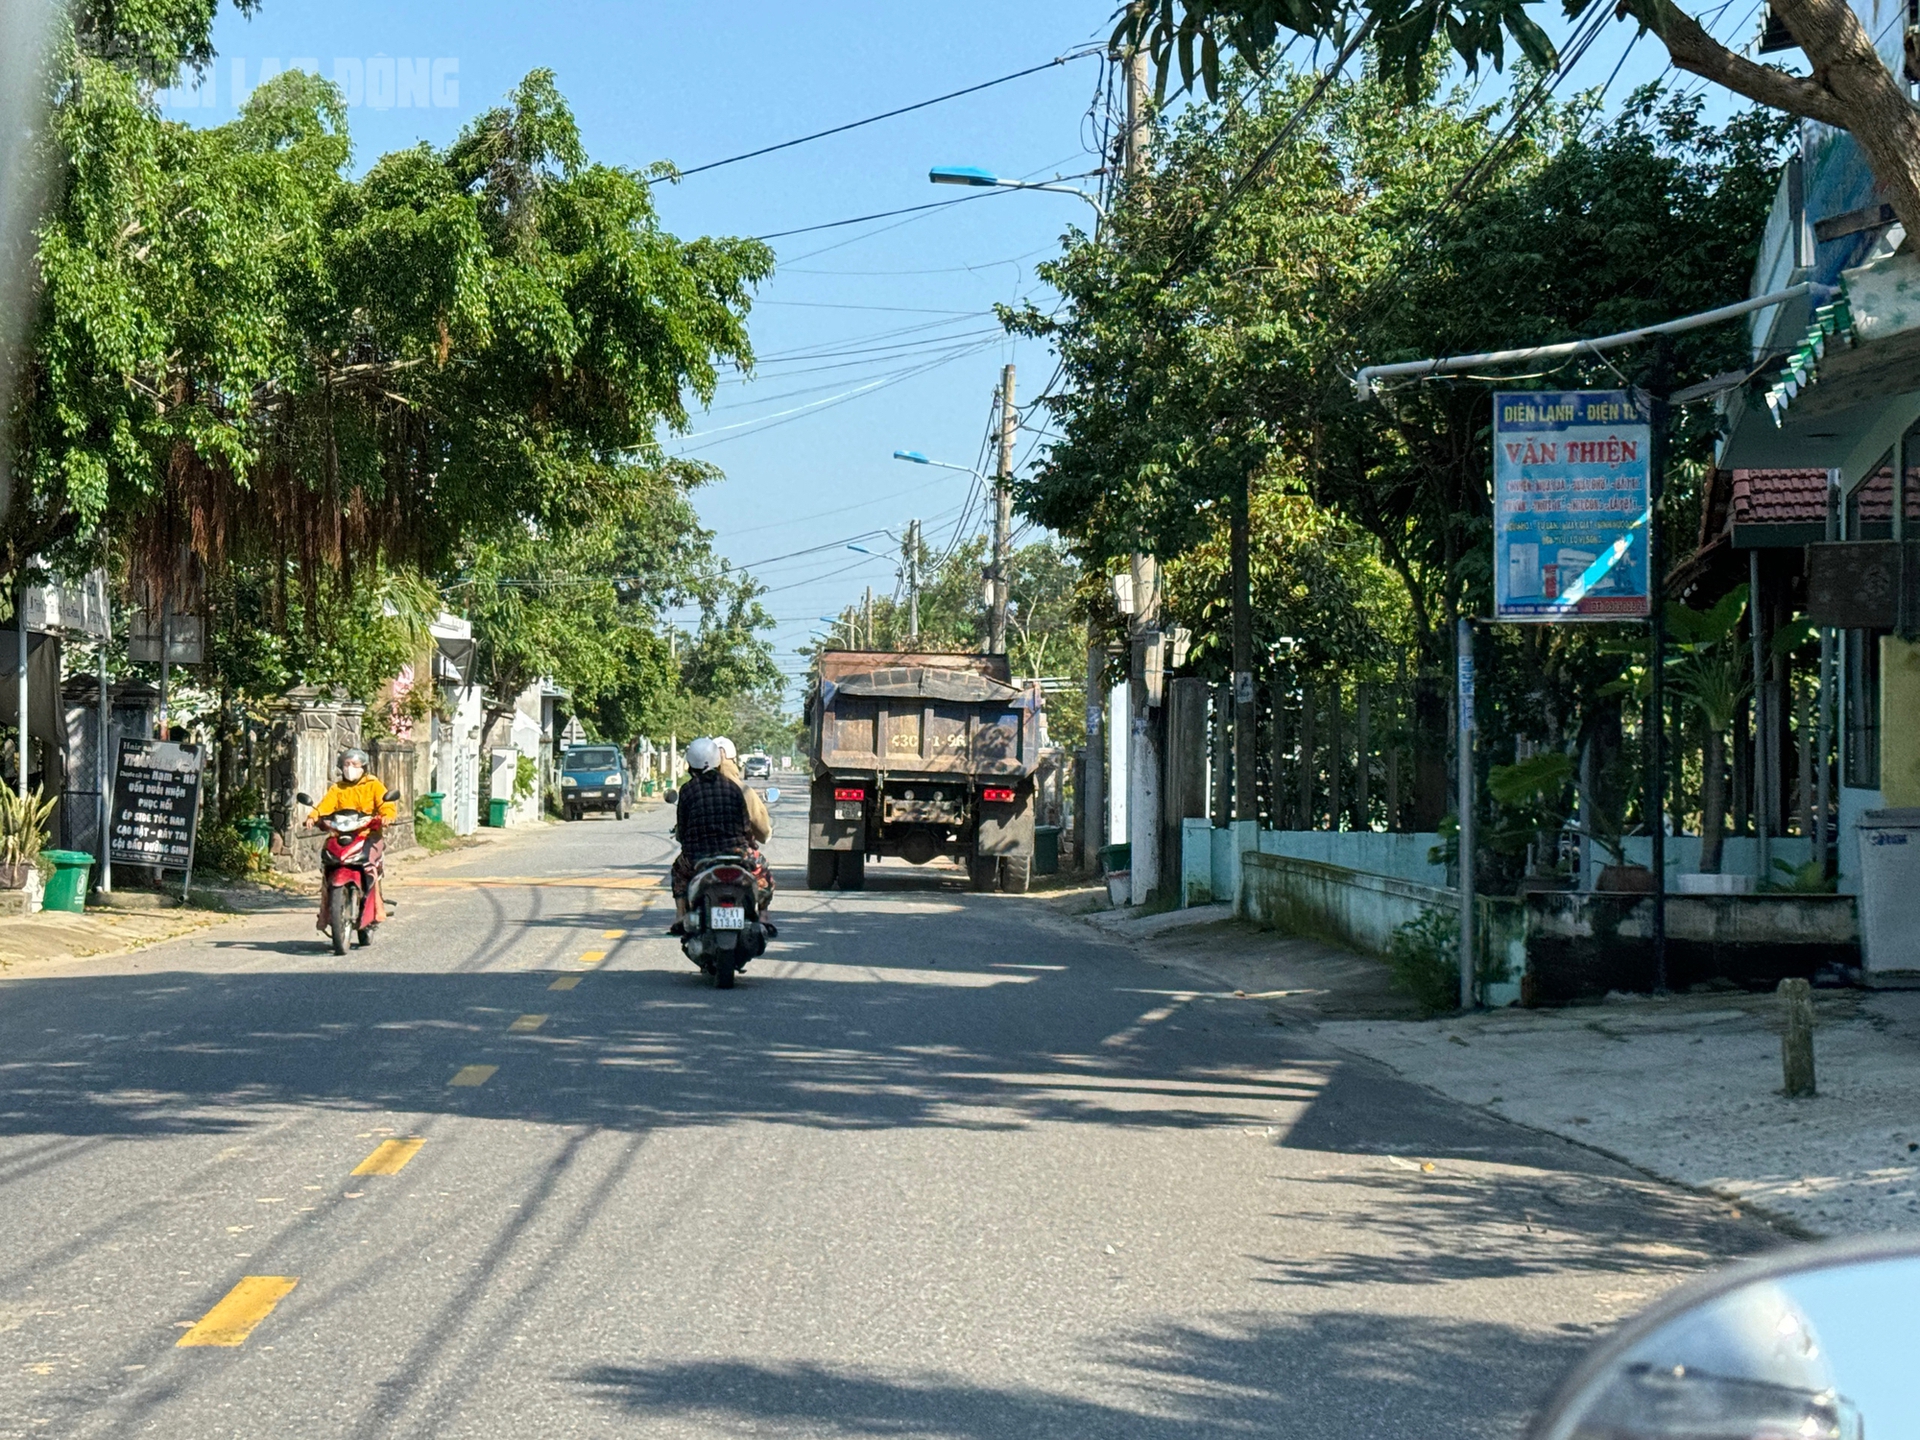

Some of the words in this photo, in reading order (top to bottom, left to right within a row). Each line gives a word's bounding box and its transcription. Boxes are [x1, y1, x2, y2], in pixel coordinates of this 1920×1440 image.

[1539, 404, 1574, 426] LẠNH
[1587, 401, 1619, 424] ĐIỆN
[1505, 437, 1557, 464] VĂN
[1564, 434, 1638, 468] THIỆN
[152, 770, 172, 782] Nam
[128, 780, 145, 793] UỐN
[134, 812, 152, 823] SIDE
[153, 812, 168, 824] TÓC
[116, 824, 132, 836] CẠO
[133, 824, 149, 838] MẶT
[175, 830, 188, 841] TAI
[112, 837, 125, 850] GỘI
[171, 845, 189, 856] SINH
